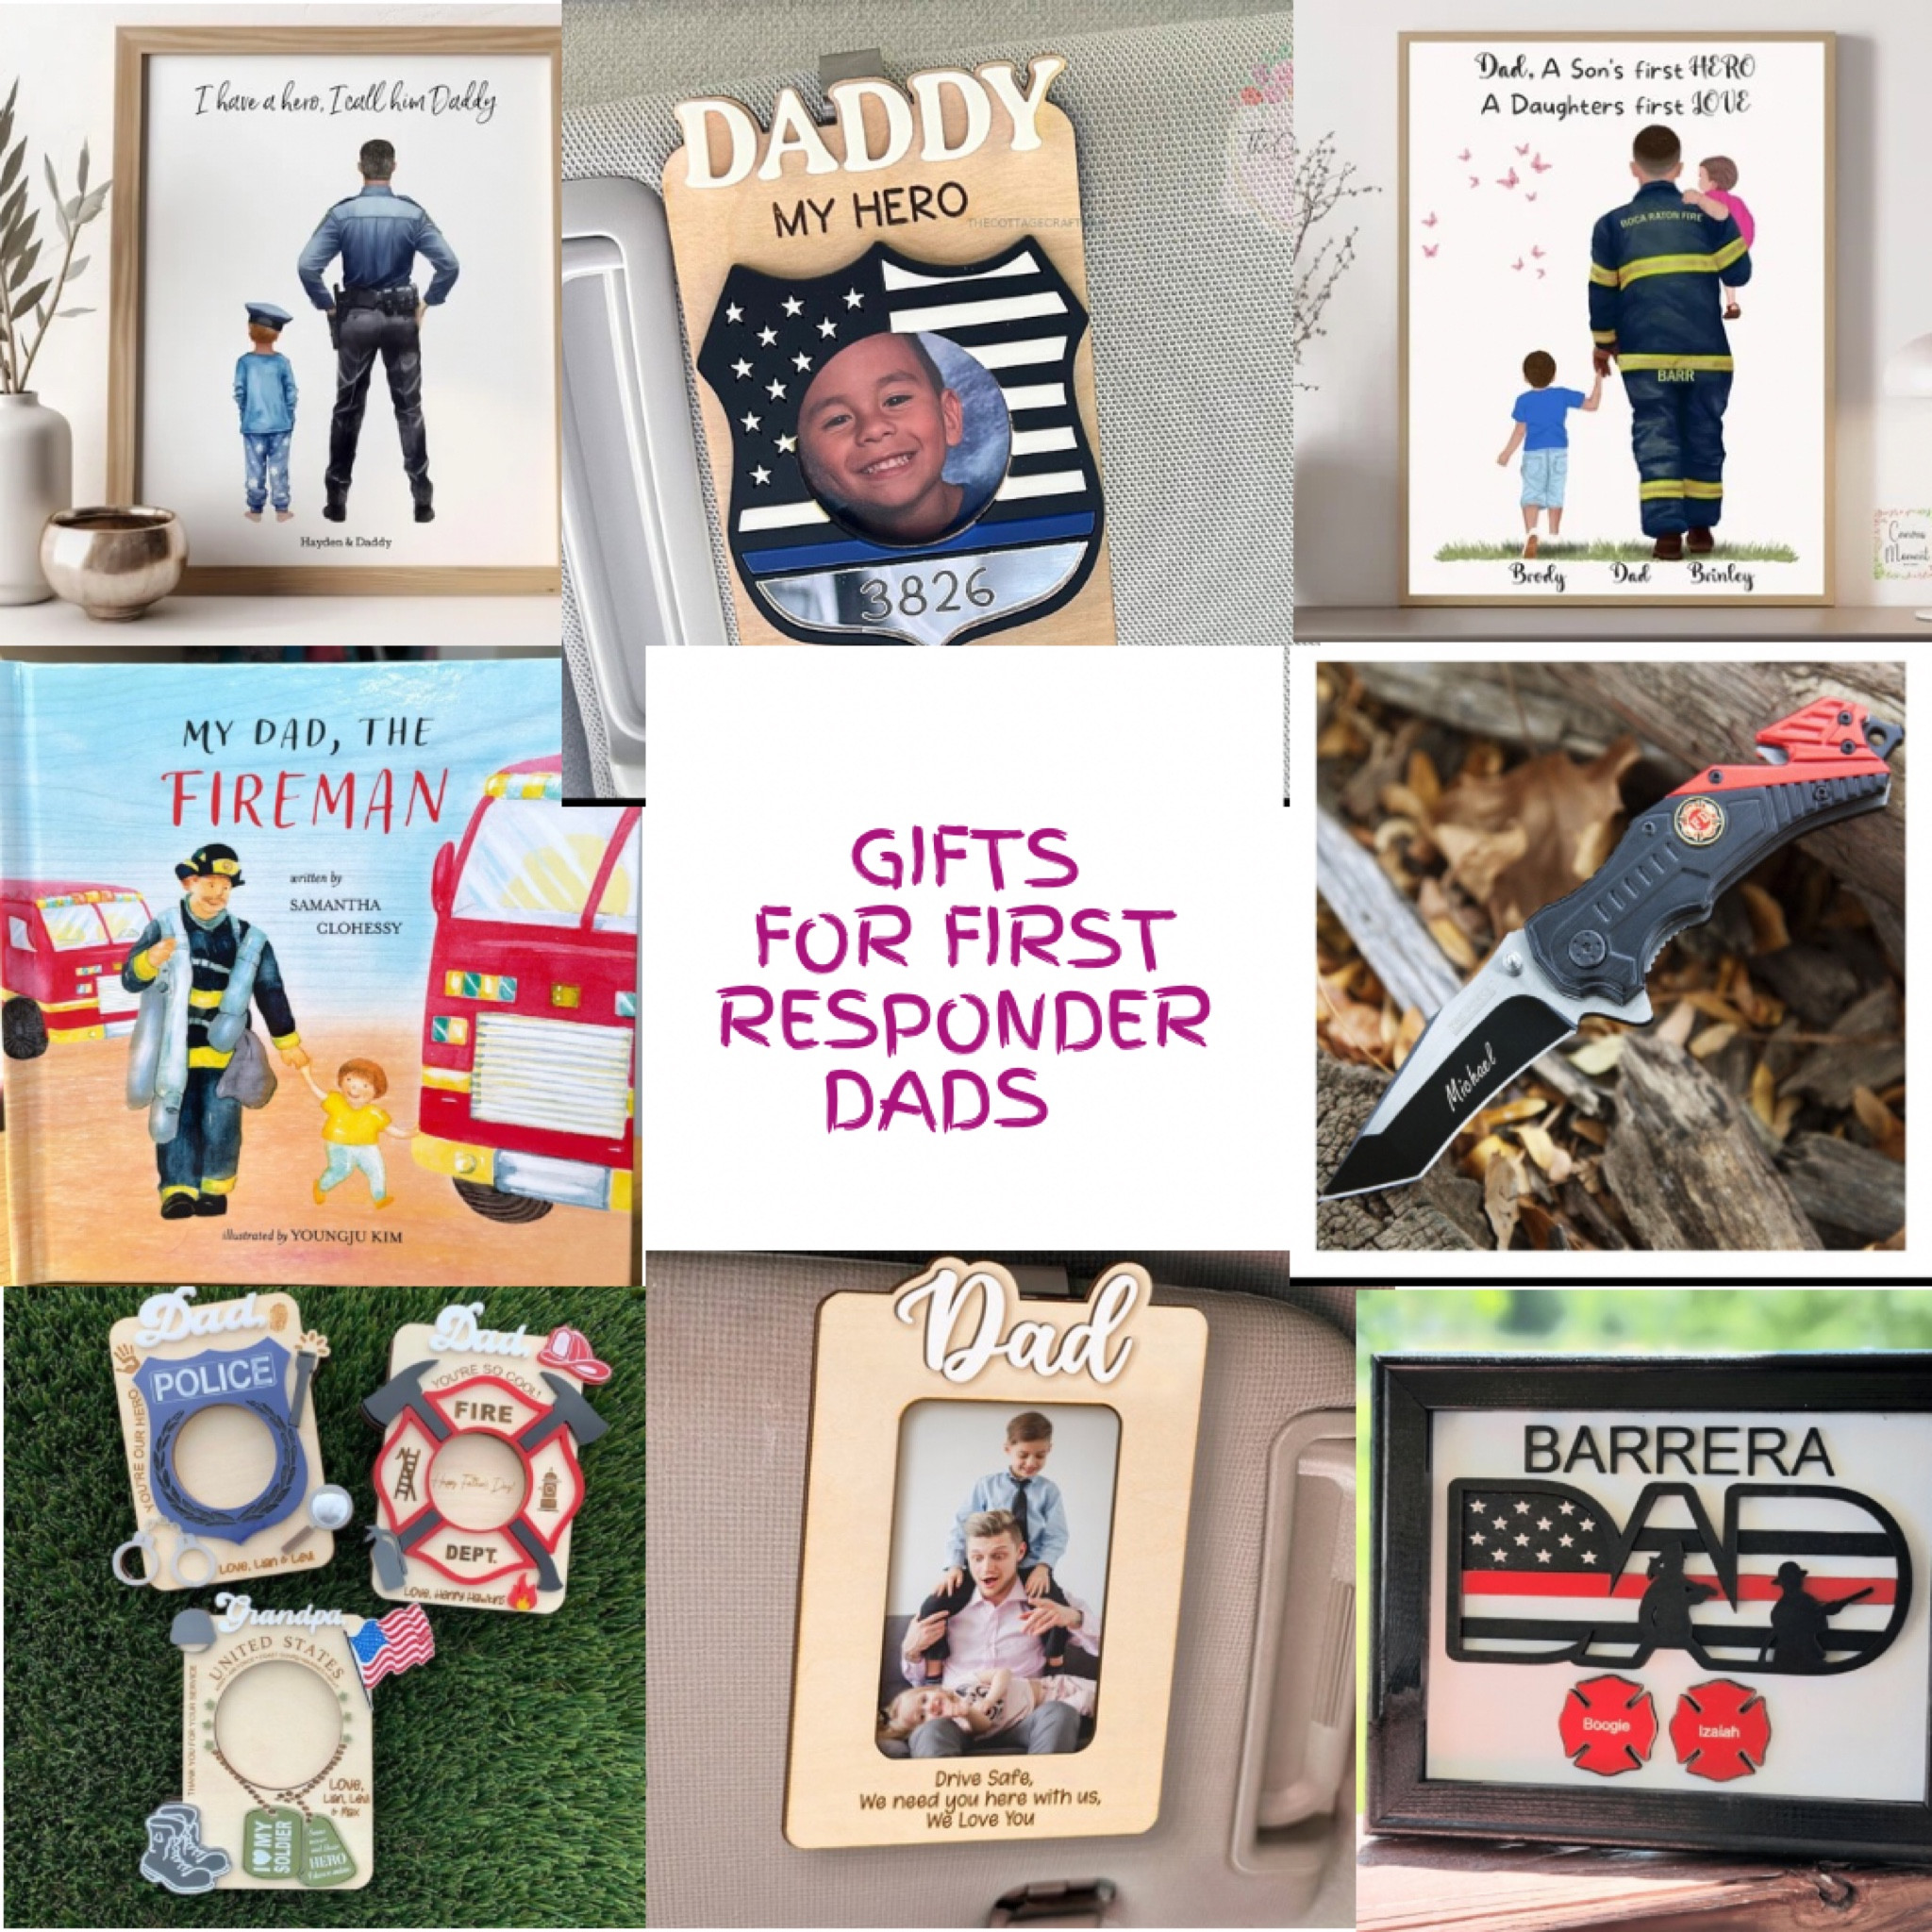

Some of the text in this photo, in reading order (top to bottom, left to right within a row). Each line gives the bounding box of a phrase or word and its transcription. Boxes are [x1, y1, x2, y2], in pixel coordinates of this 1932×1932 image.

[1474, 52, 1756, 80] Dad, A Son's first HERO
[195, 84, 213, 115] I
[217, 80, 258, 111] have
[263, 92, 275, 111] a
[329, 84, 348, 115] I
[344, 80, 387, 111] call
[390, 80, 425, 111] him
[427, 80, 497, 125] Daddy
[1480, 89, 1752, 122] A Daughters first LOVE
[675, 57, 1064, 189] DADDY
[772, 180, 969, 239] MY HERO
[1620, 210, 1702, 227] BOCA RATON FIRE
[1657, 369, 1696, 383] BARR
[300, 537, 392, 549] Hayden & Daddy
[1508, 561, 1754, 592] Brody Dad Brinley
[859, 566, 996, 622] 3826
[183, 716, 433, 757] MY DAD, THE
[160, 768, 449, 834] FIREMAN
[289, 871, 342, 888] written by
[290, 898, 382, 911] SAMANTHA
[316, 922, 403, 935] CLOHESSY
[1445, 1041, 1497, 1112] Michael
[222, 1229, 403, 1245] illustrated by YOUNGJU KIM
[896, 1269, 1137, 1383] Dad
[153, 1356, 274, 1402] POLICE
[431, 1364, 541, 1397] YOU'RE SO COOL!
[454, 1400, 513, 1424] FIRE
[128, 1389, 155, 1513] YOU'RE OUR HERO
[1524, 1425, 1834, 1476] BARRERA
[445, 1543, 497, 1564] DEPT.
[1446, 1477, 1912, 1675] DAD
[208, 1636, 273, 1681] UNITED
[283, 1636, 344, 1680] STATES
[188, 1703, 196, 1726] YOUR
[1582, 1717, 1631, 1734] Boogie
[188, 1729, 196, 1746] FOR
[188, 1748, 196, 1766] YOU
[935, 1769, 1033, 1788] Drive Safe,
[859, 1789, 1102, 1814] We need you here with us,
[925, 1810, 1035, 1828] We Love You
[254, 1821, 273, 1848] MY
[274, 1821, 292, 1874] SOLDIER
[309, 1852, 347, 1870] HERO
